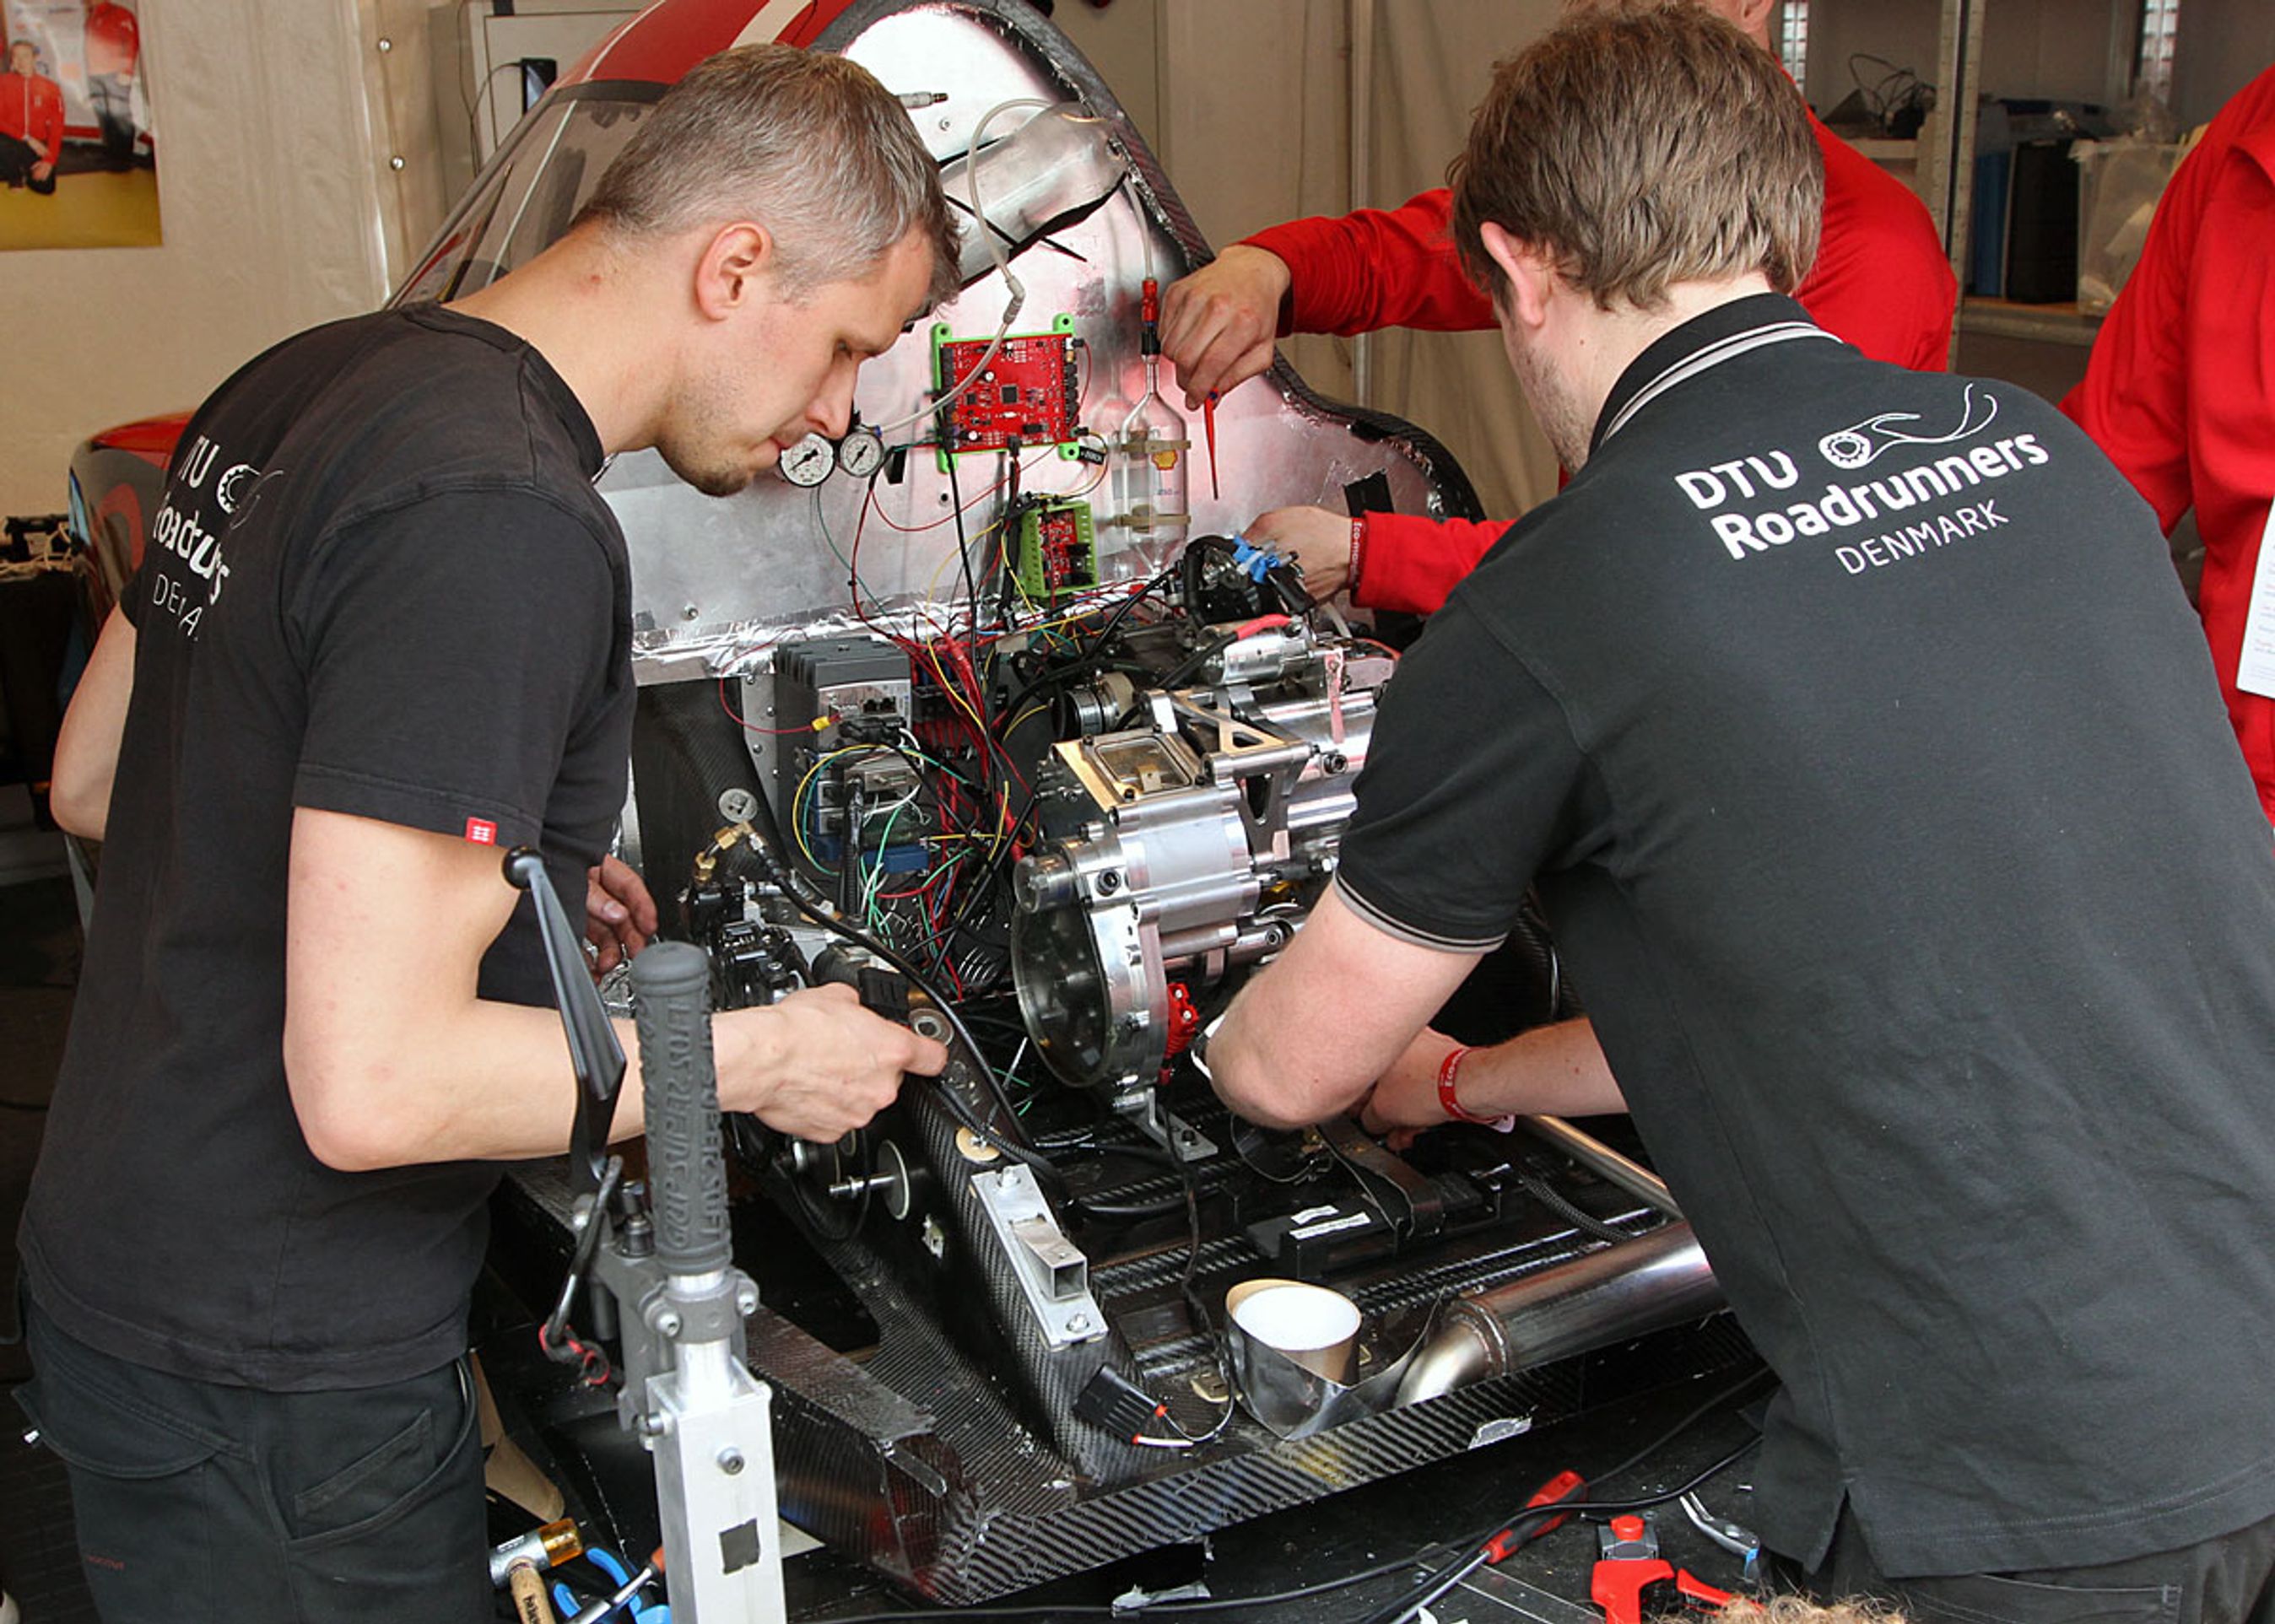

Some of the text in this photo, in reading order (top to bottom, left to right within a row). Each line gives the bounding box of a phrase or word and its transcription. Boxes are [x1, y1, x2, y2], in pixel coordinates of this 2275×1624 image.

[1674, 451, 1799, 509] DTU
[1710, 434, 2049, 560] Roadrunners
[1835, 499, 2009, 575] DENMARK
[666, 1004, 692, 1070] SOFT
[664, 1077, 692, 1173] SUPER
